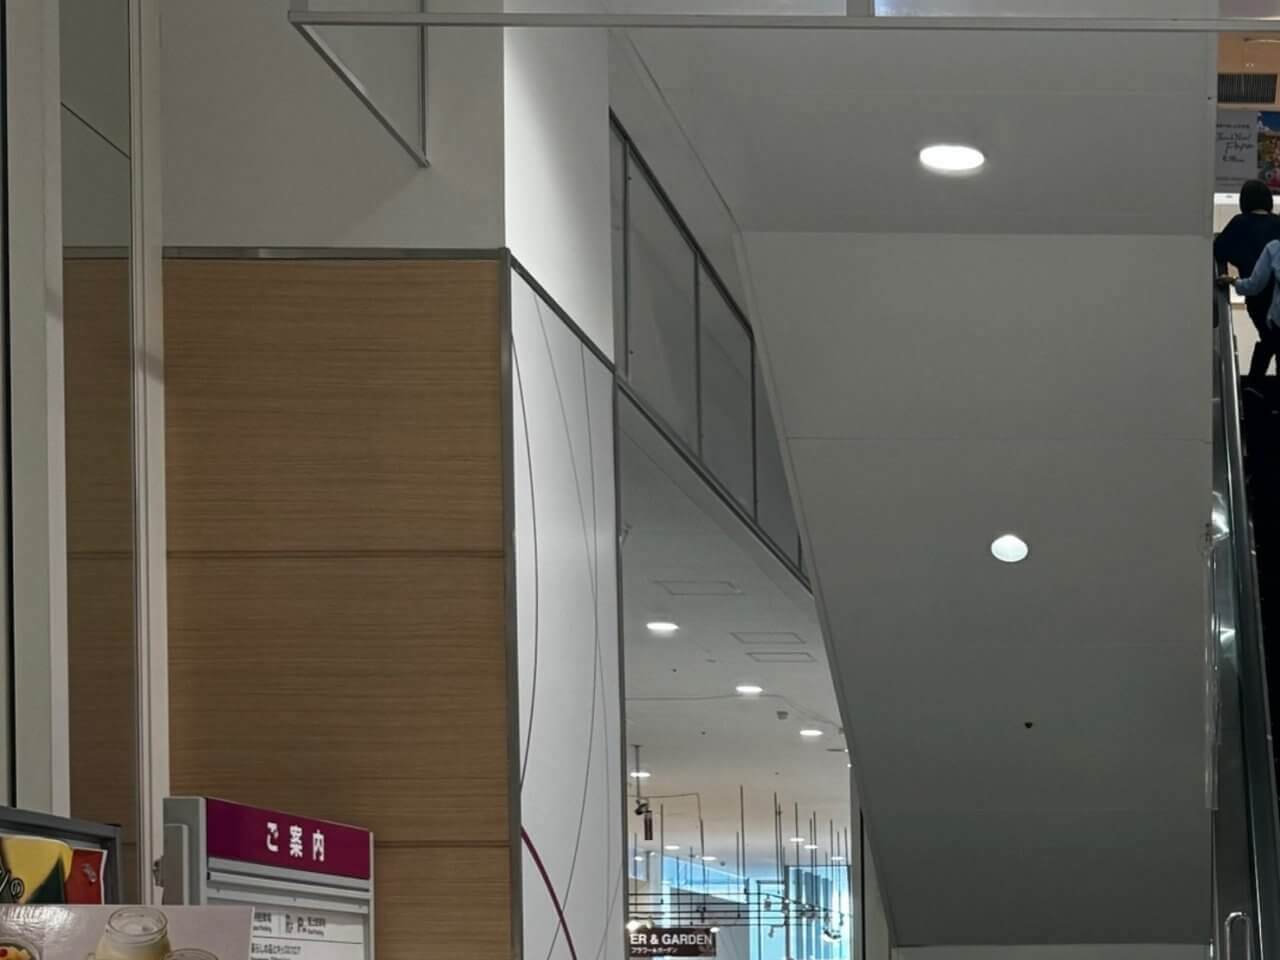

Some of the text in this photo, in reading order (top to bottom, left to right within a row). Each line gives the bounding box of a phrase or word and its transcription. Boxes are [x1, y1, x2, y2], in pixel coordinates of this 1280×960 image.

[266, 821, 326, 863] ご案内
[649, 933, 659, 945] &
[661, 933, 713, 945] GARDEN
